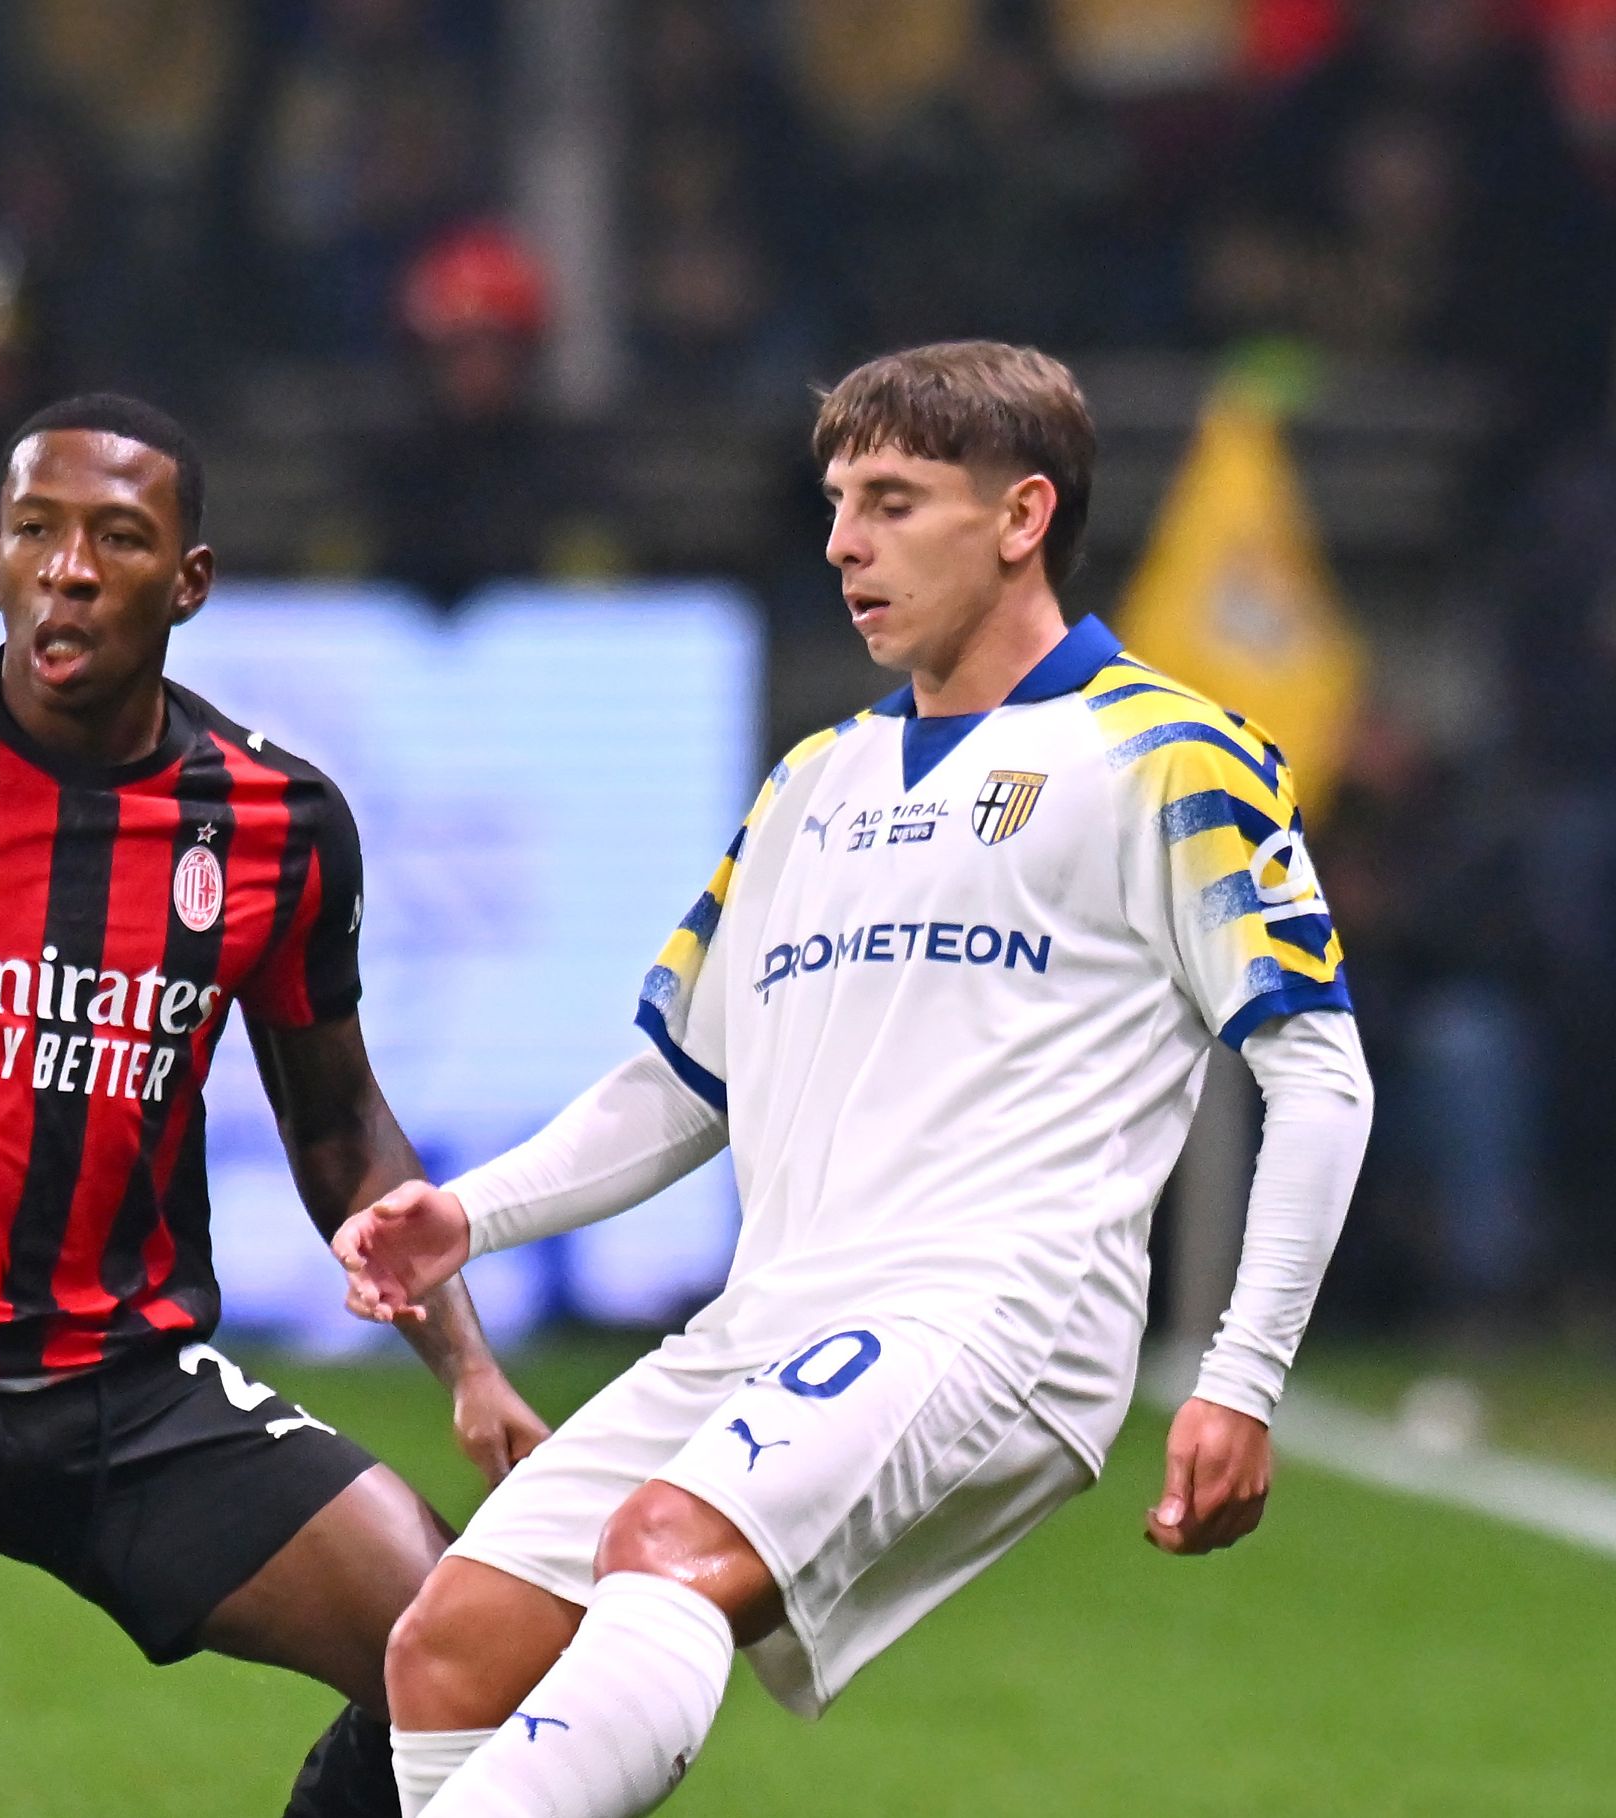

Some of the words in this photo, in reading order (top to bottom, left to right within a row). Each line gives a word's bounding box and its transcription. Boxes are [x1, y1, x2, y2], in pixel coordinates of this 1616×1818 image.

[753, 921, 1052, 1006] PROMETEON
[32, 1032, 176, 1102] BETTER
[744, 1329, 882, 1400] 0
